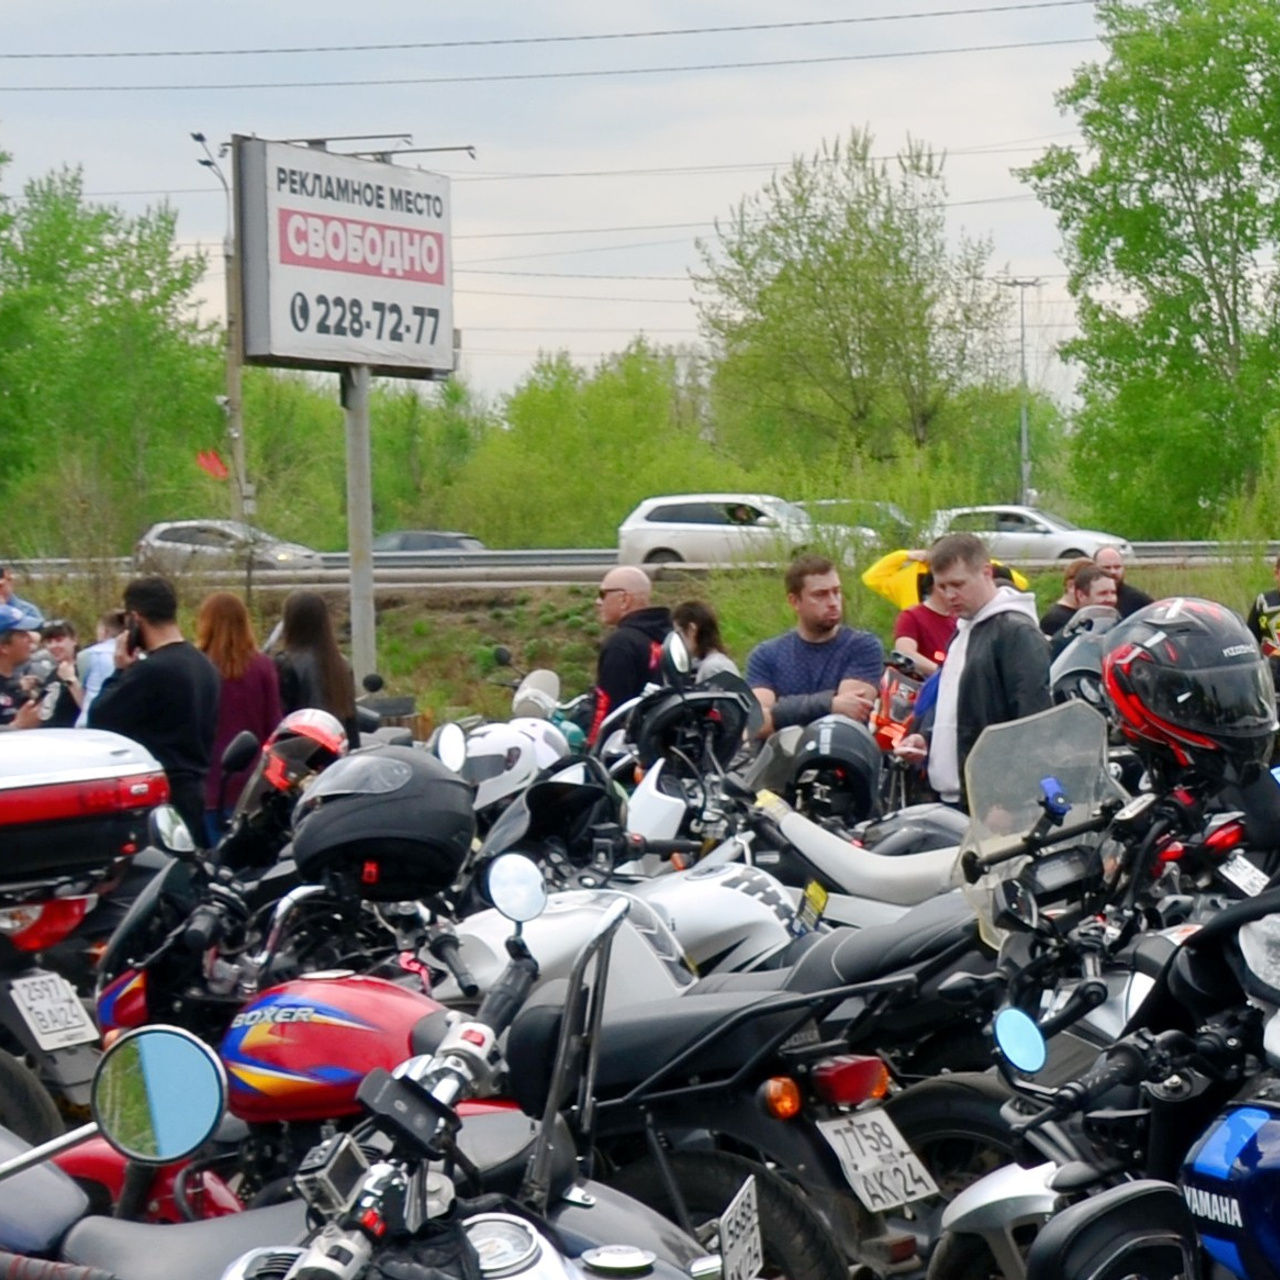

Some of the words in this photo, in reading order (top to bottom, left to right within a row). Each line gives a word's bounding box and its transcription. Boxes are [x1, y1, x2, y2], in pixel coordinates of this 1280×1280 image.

[277, 167, 385, 209] РЕКЛАМНОЕ
[390, 187, 443, 218] МЕСТО
[286, 214, 440, 276] СВОБОДНО
[315, 294, 440, 345] 228-72-77
[231, 1006, 316, 1029] BOXER
[832, 1121, 893, 1160] 7758
[862, 1170, 900, 1207] AK
[893, 1162, 931, 1196] 24
[1183, 1184, 1244, 1228] YAMAHA
